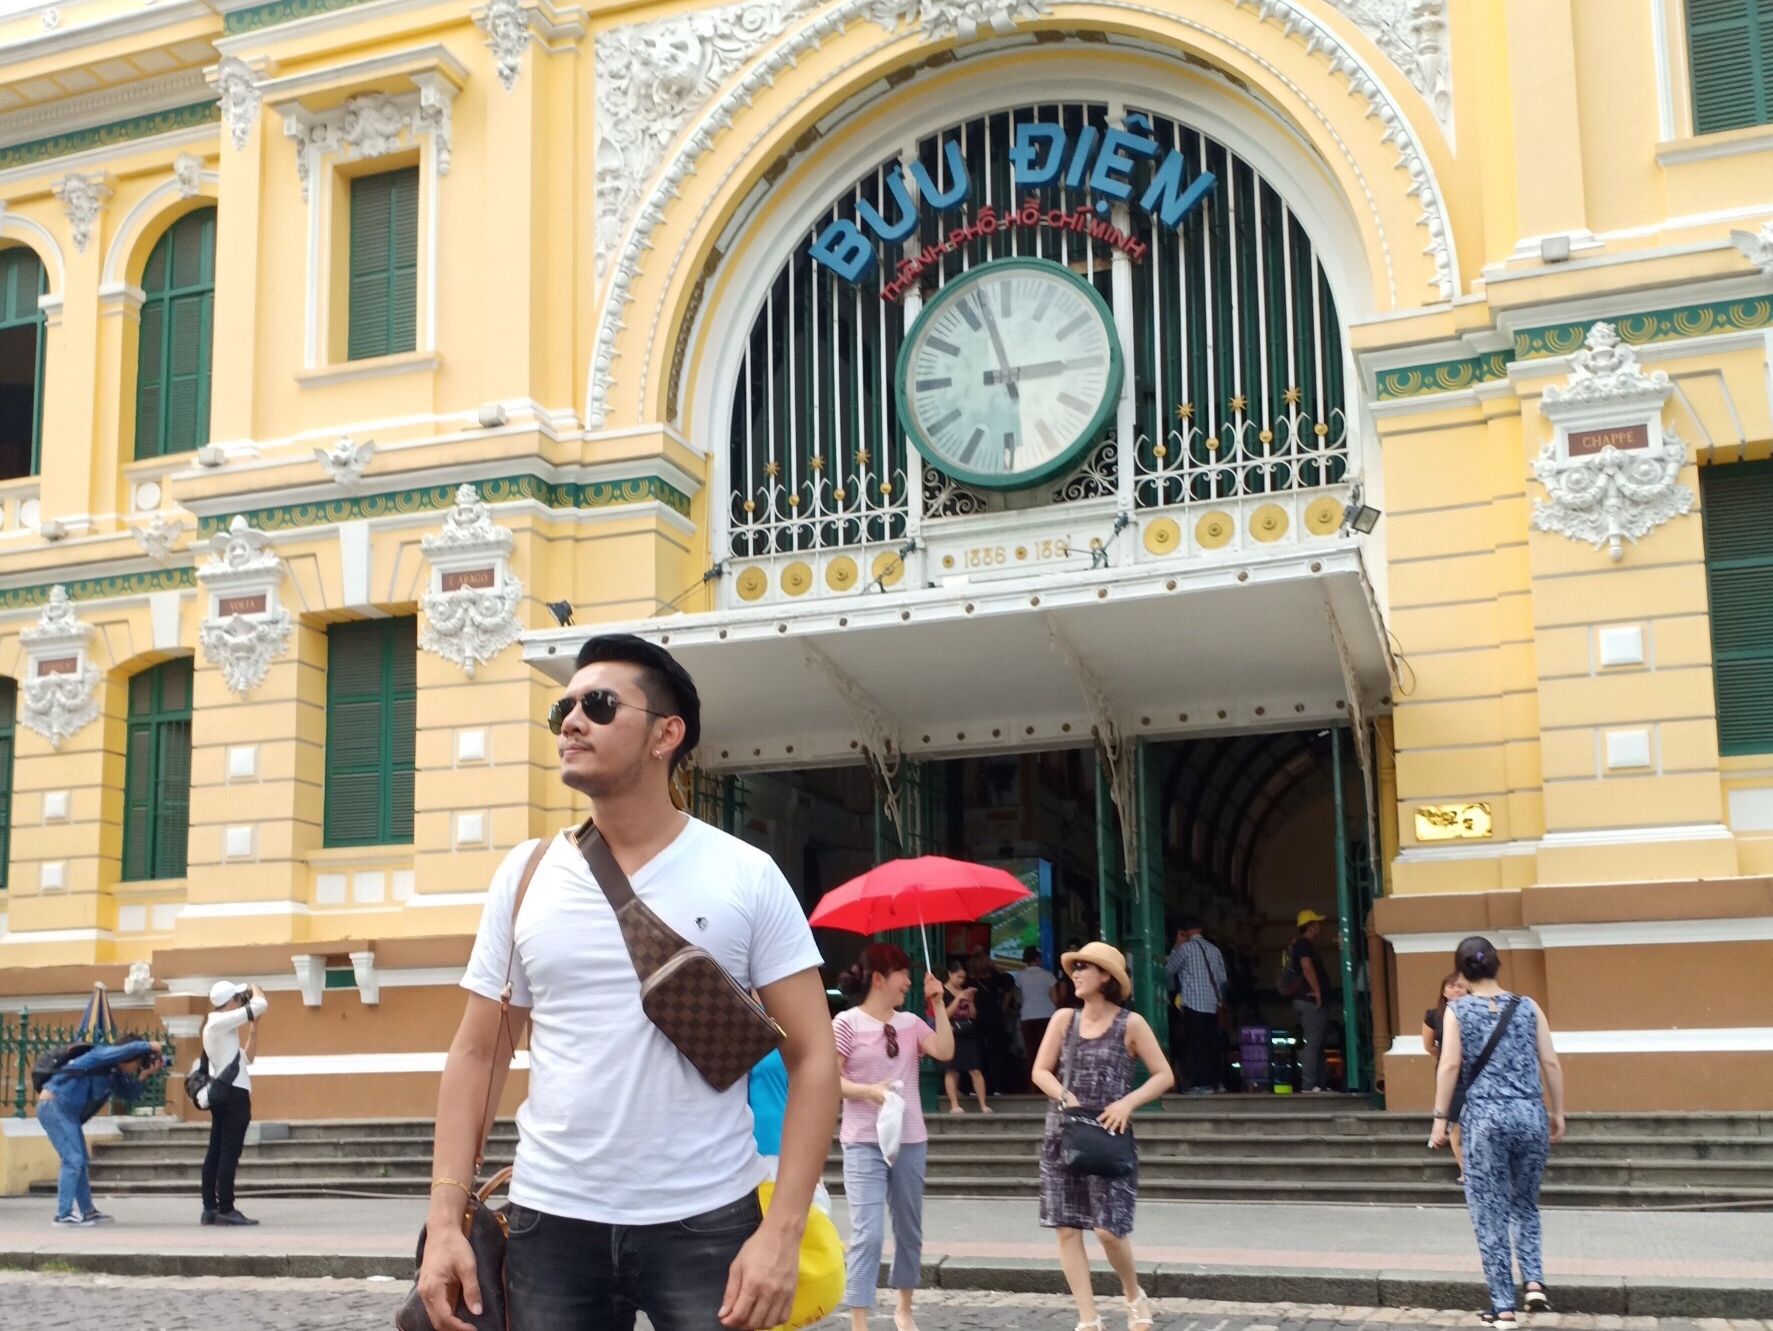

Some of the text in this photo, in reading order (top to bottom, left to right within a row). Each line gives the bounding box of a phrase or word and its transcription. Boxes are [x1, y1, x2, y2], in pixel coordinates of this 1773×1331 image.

[1008, 112, 1216, 228] ĐIỆN
[1088, 218, 1147, 259] MINH
[1582, 431, 1634, 448] CHAPPE
[963, 546, 1006, 569] 1886
